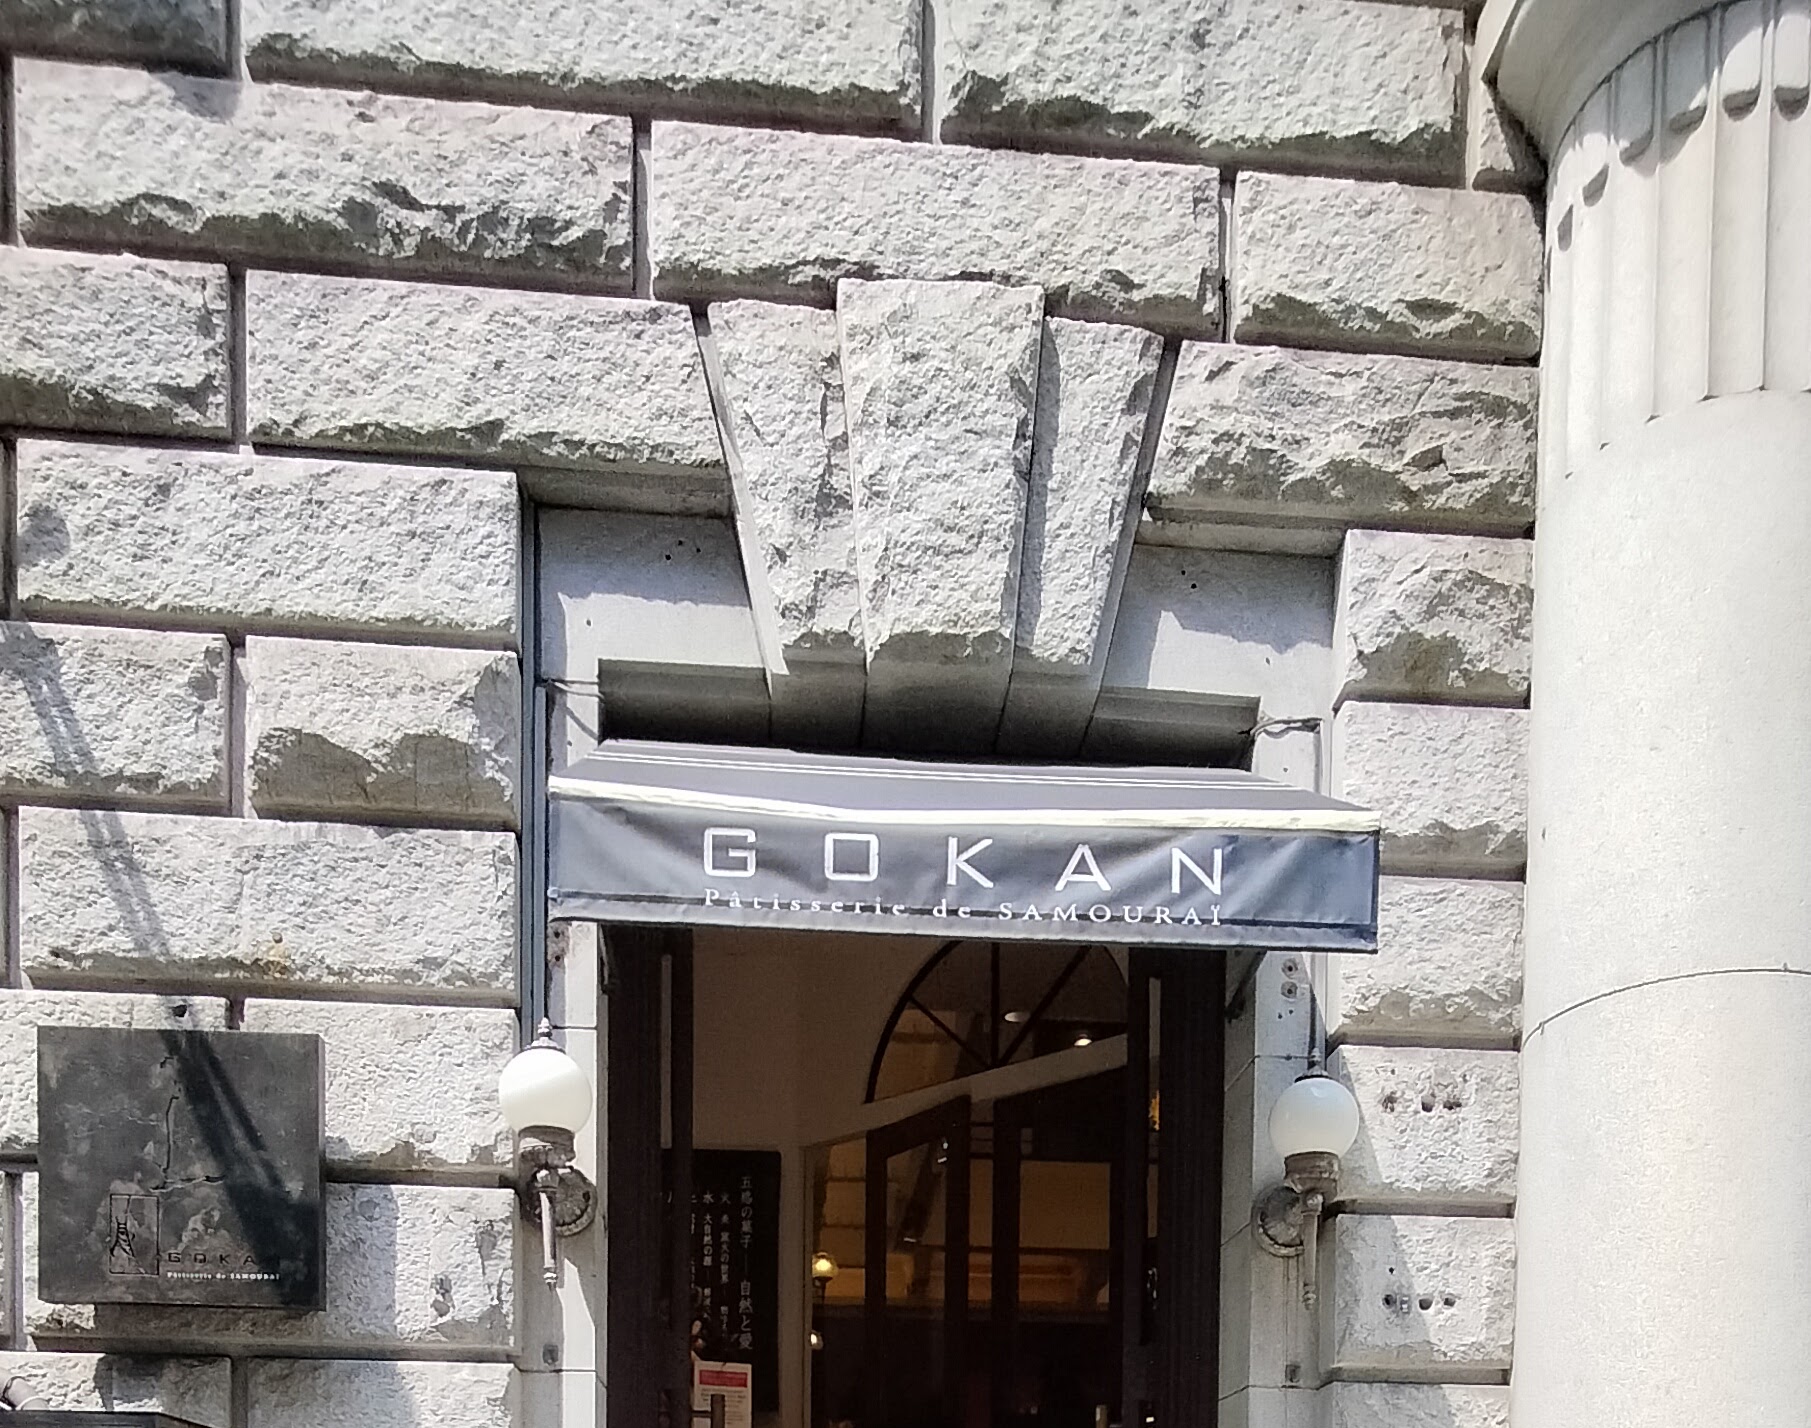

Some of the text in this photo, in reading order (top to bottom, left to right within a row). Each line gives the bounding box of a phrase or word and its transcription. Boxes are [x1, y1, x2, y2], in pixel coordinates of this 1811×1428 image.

[703, 826, 1225, 896] GOKAN
[704, 887, 906, 917] Pâtisserie
[932, 898, 972, 919] de
